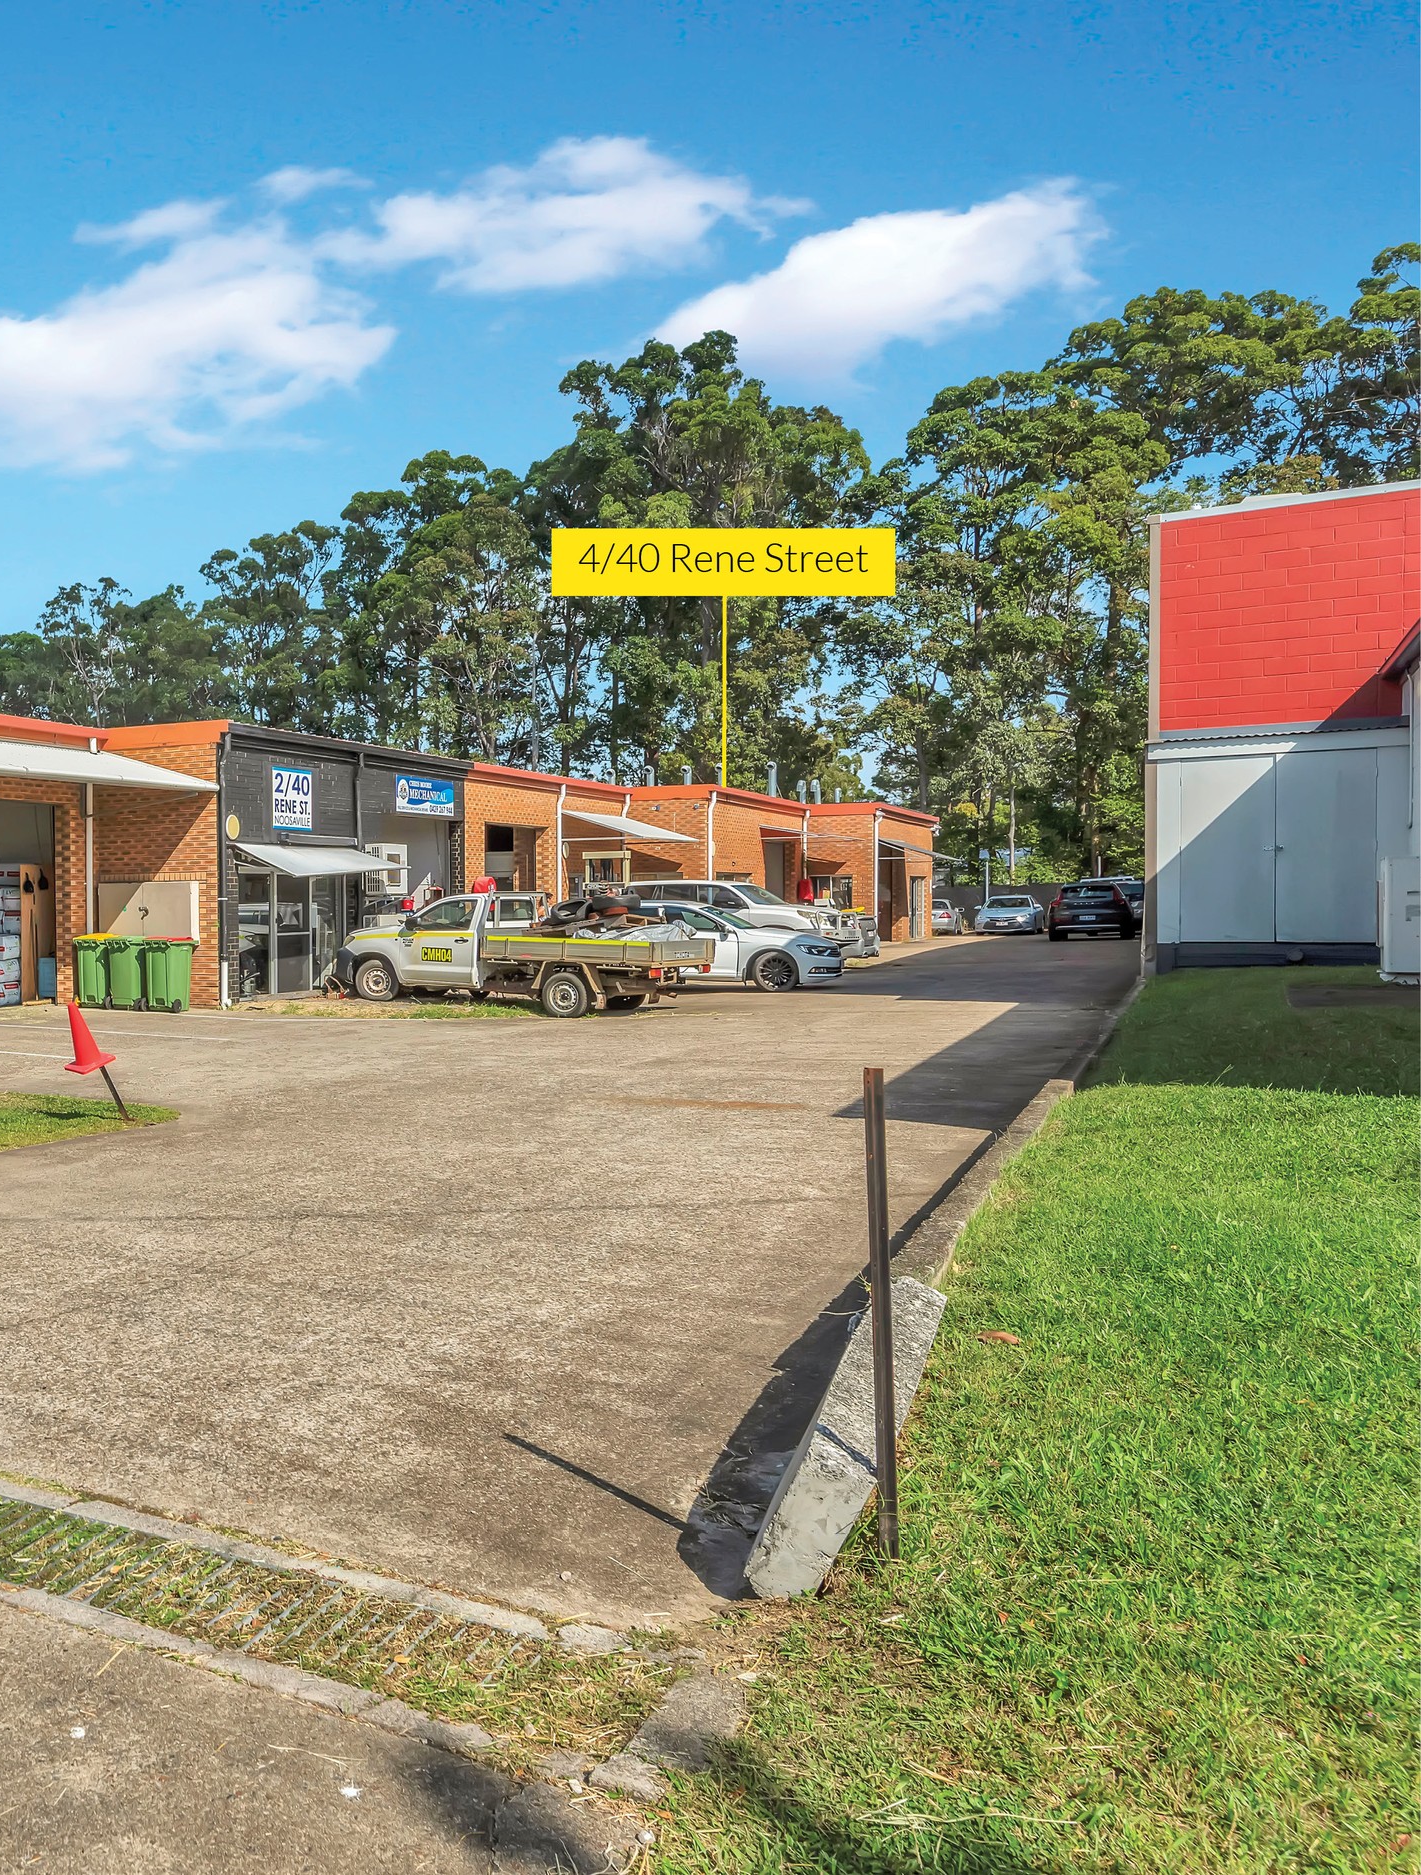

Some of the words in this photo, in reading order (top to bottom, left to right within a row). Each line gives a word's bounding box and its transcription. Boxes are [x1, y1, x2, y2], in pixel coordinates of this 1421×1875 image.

[274, 772, 310, 797] 2/40
[409, 789, 447, 802] MECHANICAL
[274, 798, 297, 814] RENE
[299, 801, 310, 815] ST.
[274, 815, 310, 827] NOOSAVILLE
[422, 947, 452, 962] CMH04
